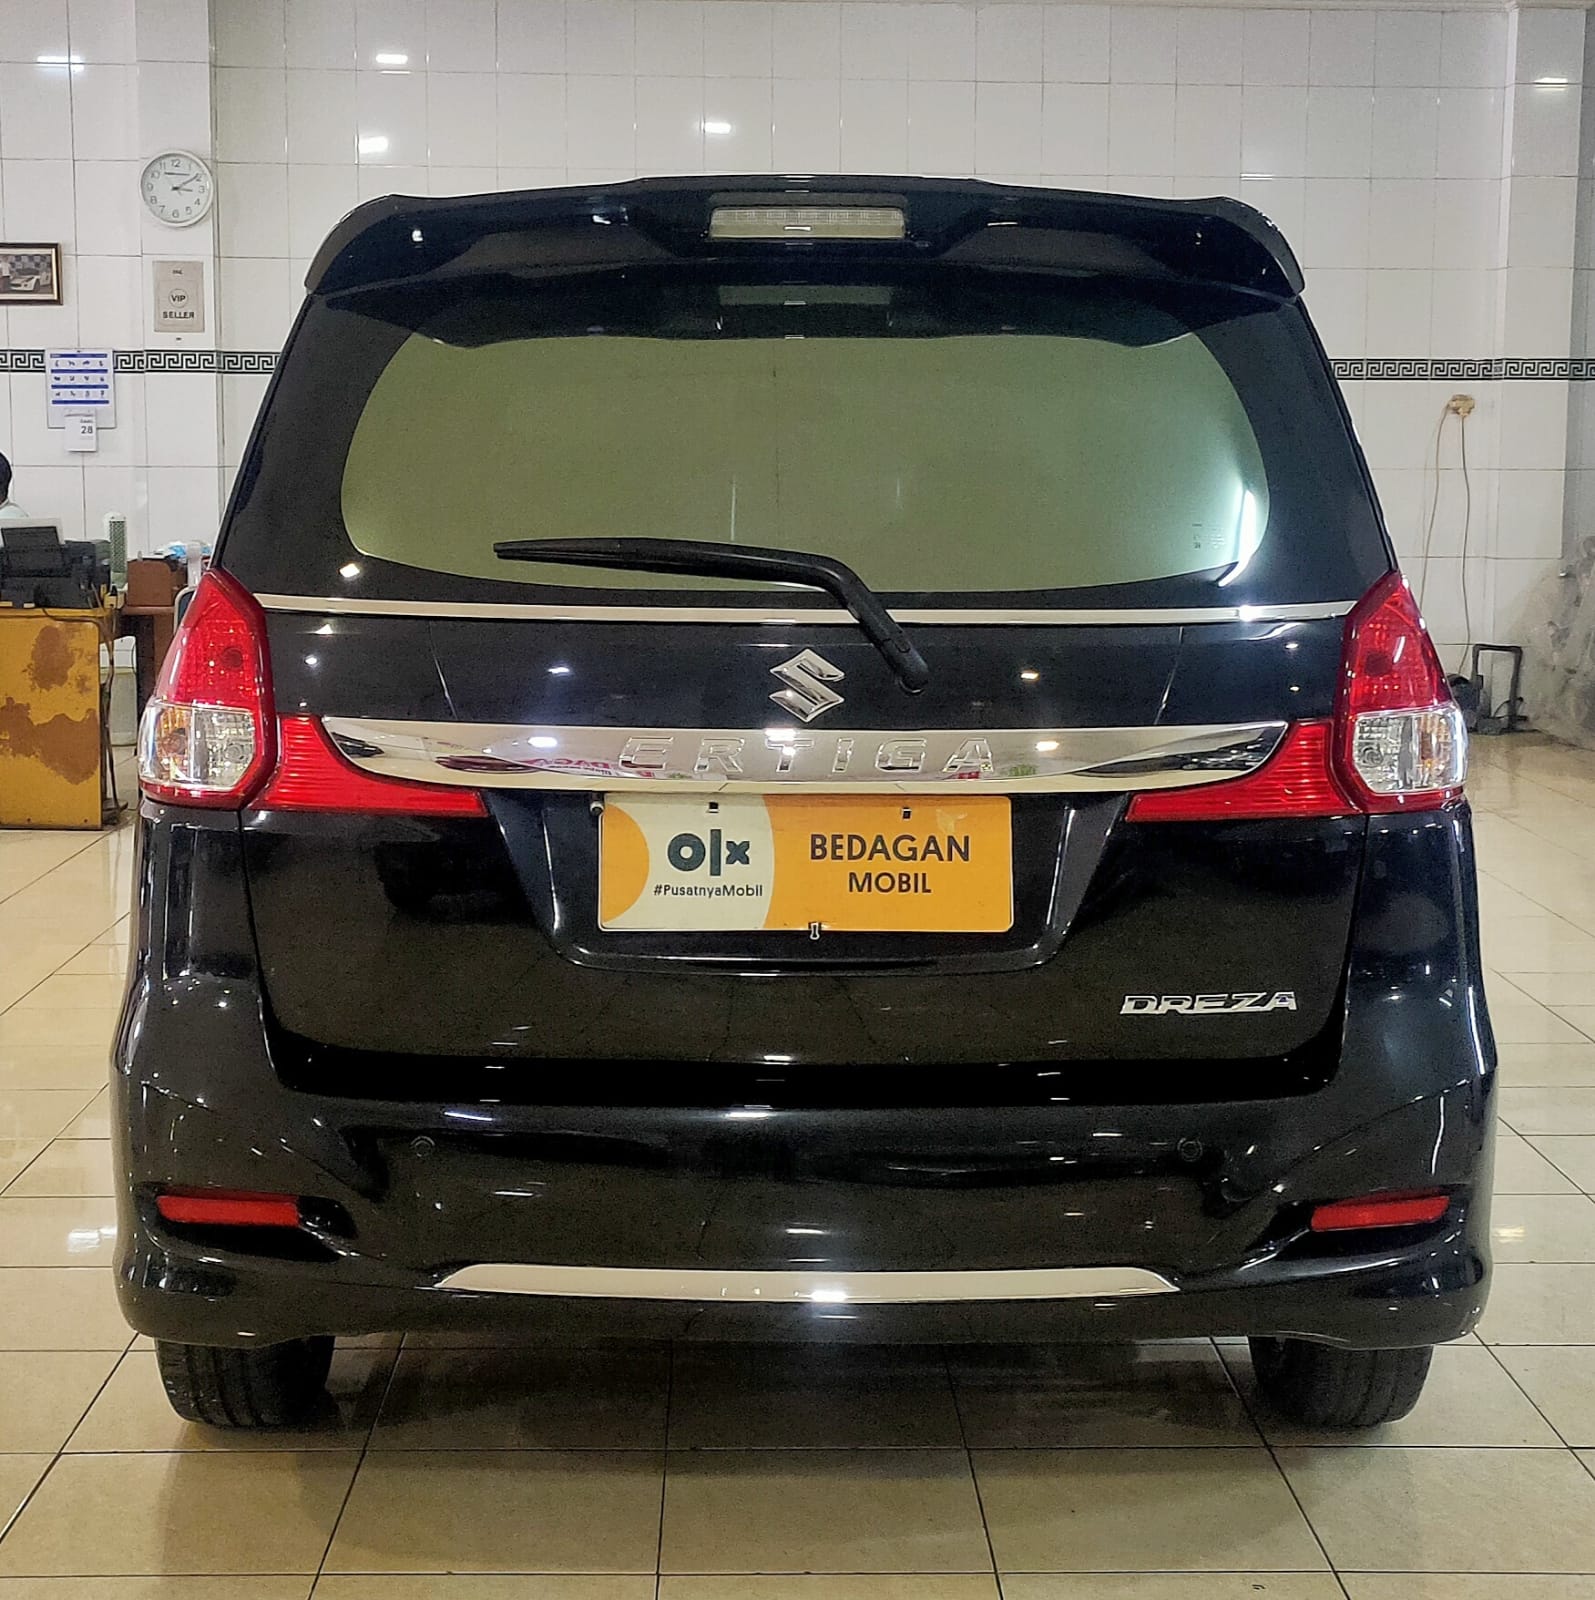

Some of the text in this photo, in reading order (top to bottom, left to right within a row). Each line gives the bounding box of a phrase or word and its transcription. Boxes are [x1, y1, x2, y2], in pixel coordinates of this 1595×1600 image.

[171, 159, 181, 168] 12
[150, 195, 158, 205] 8
[171, 294, 186, 302] VIP
[162, 311, 195, 319] SELLER
[81, 425, 93, 434] 28
[618, 736, 995, 774] ERTIGA
[810, 833, 970, 863] BEDAGAN
[848, 871, 932, 894] MOBIL
[653, 883, 763, 899] #PusatnyaMobil
[1119, 991, 1297, 1015] DREZA
